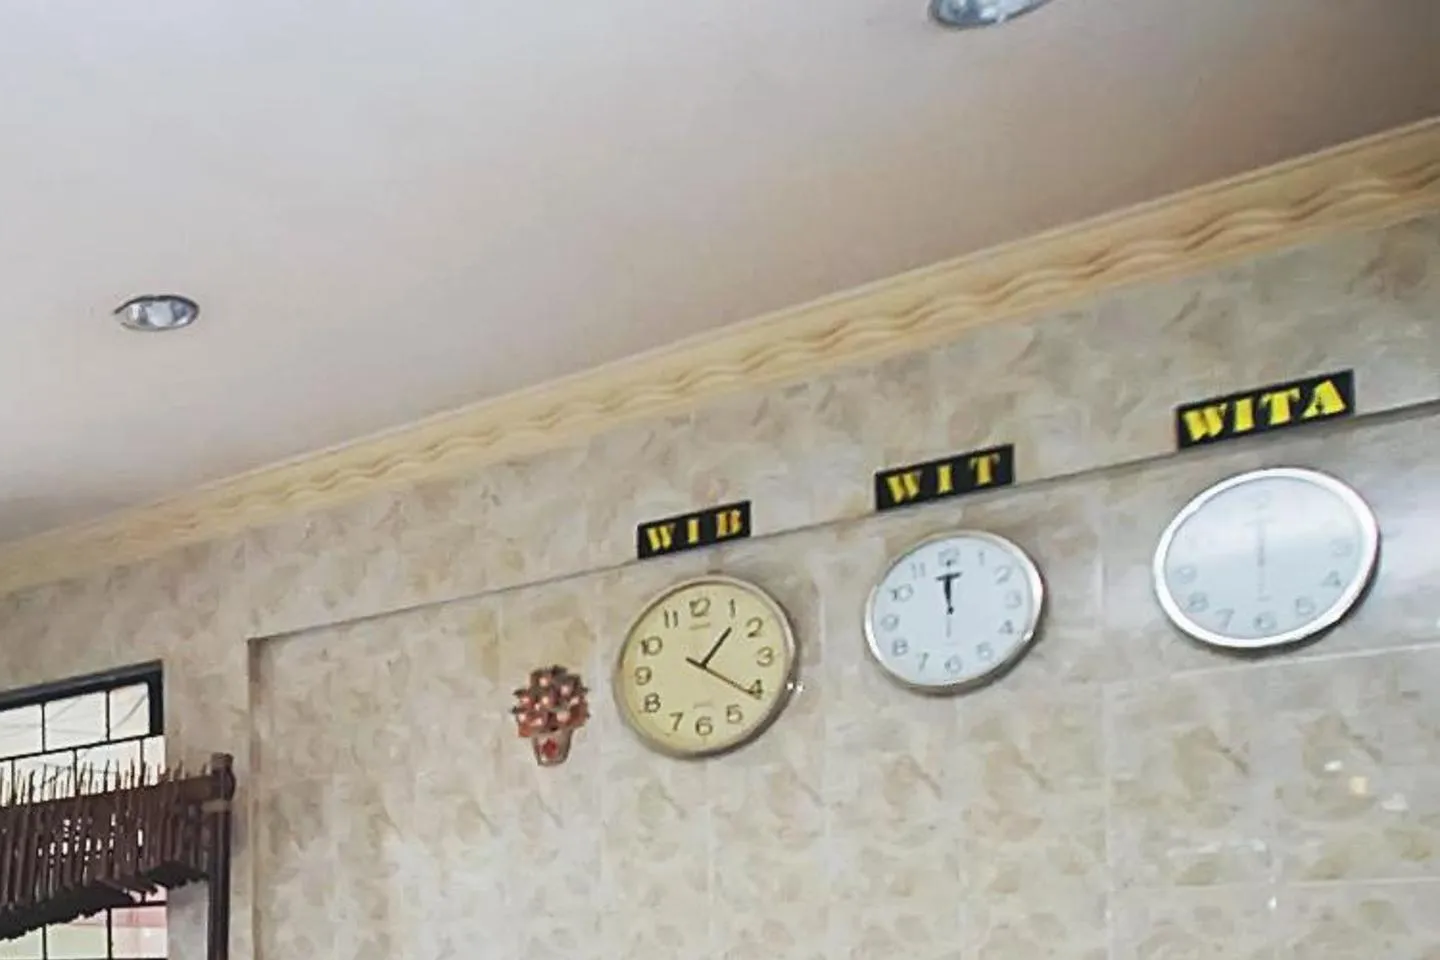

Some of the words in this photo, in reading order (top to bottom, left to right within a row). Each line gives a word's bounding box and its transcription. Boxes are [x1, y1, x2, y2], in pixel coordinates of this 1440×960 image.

[1182, 379, 1347, 442] WITA
[885, 452, 1001, 504] WIT
[647, 509, 741, 551] WIB
[689, 597, 711, 618] 12
[728, 598, 737, 619] 1
[663, 609, 679, 629] 11
[745, 616, 764, 638] 2
[640, 635, 664, 657] 10
[756, 646, 775, 668] 3
[634, 665, 653, 686] 9
[747, 678, 764, 700] 4
[643, 692, 662, 714] 8
[725, 703, 744, 725] 5
[669, 711, 685, 732] 7
[694, 715, 714, 737] 6
